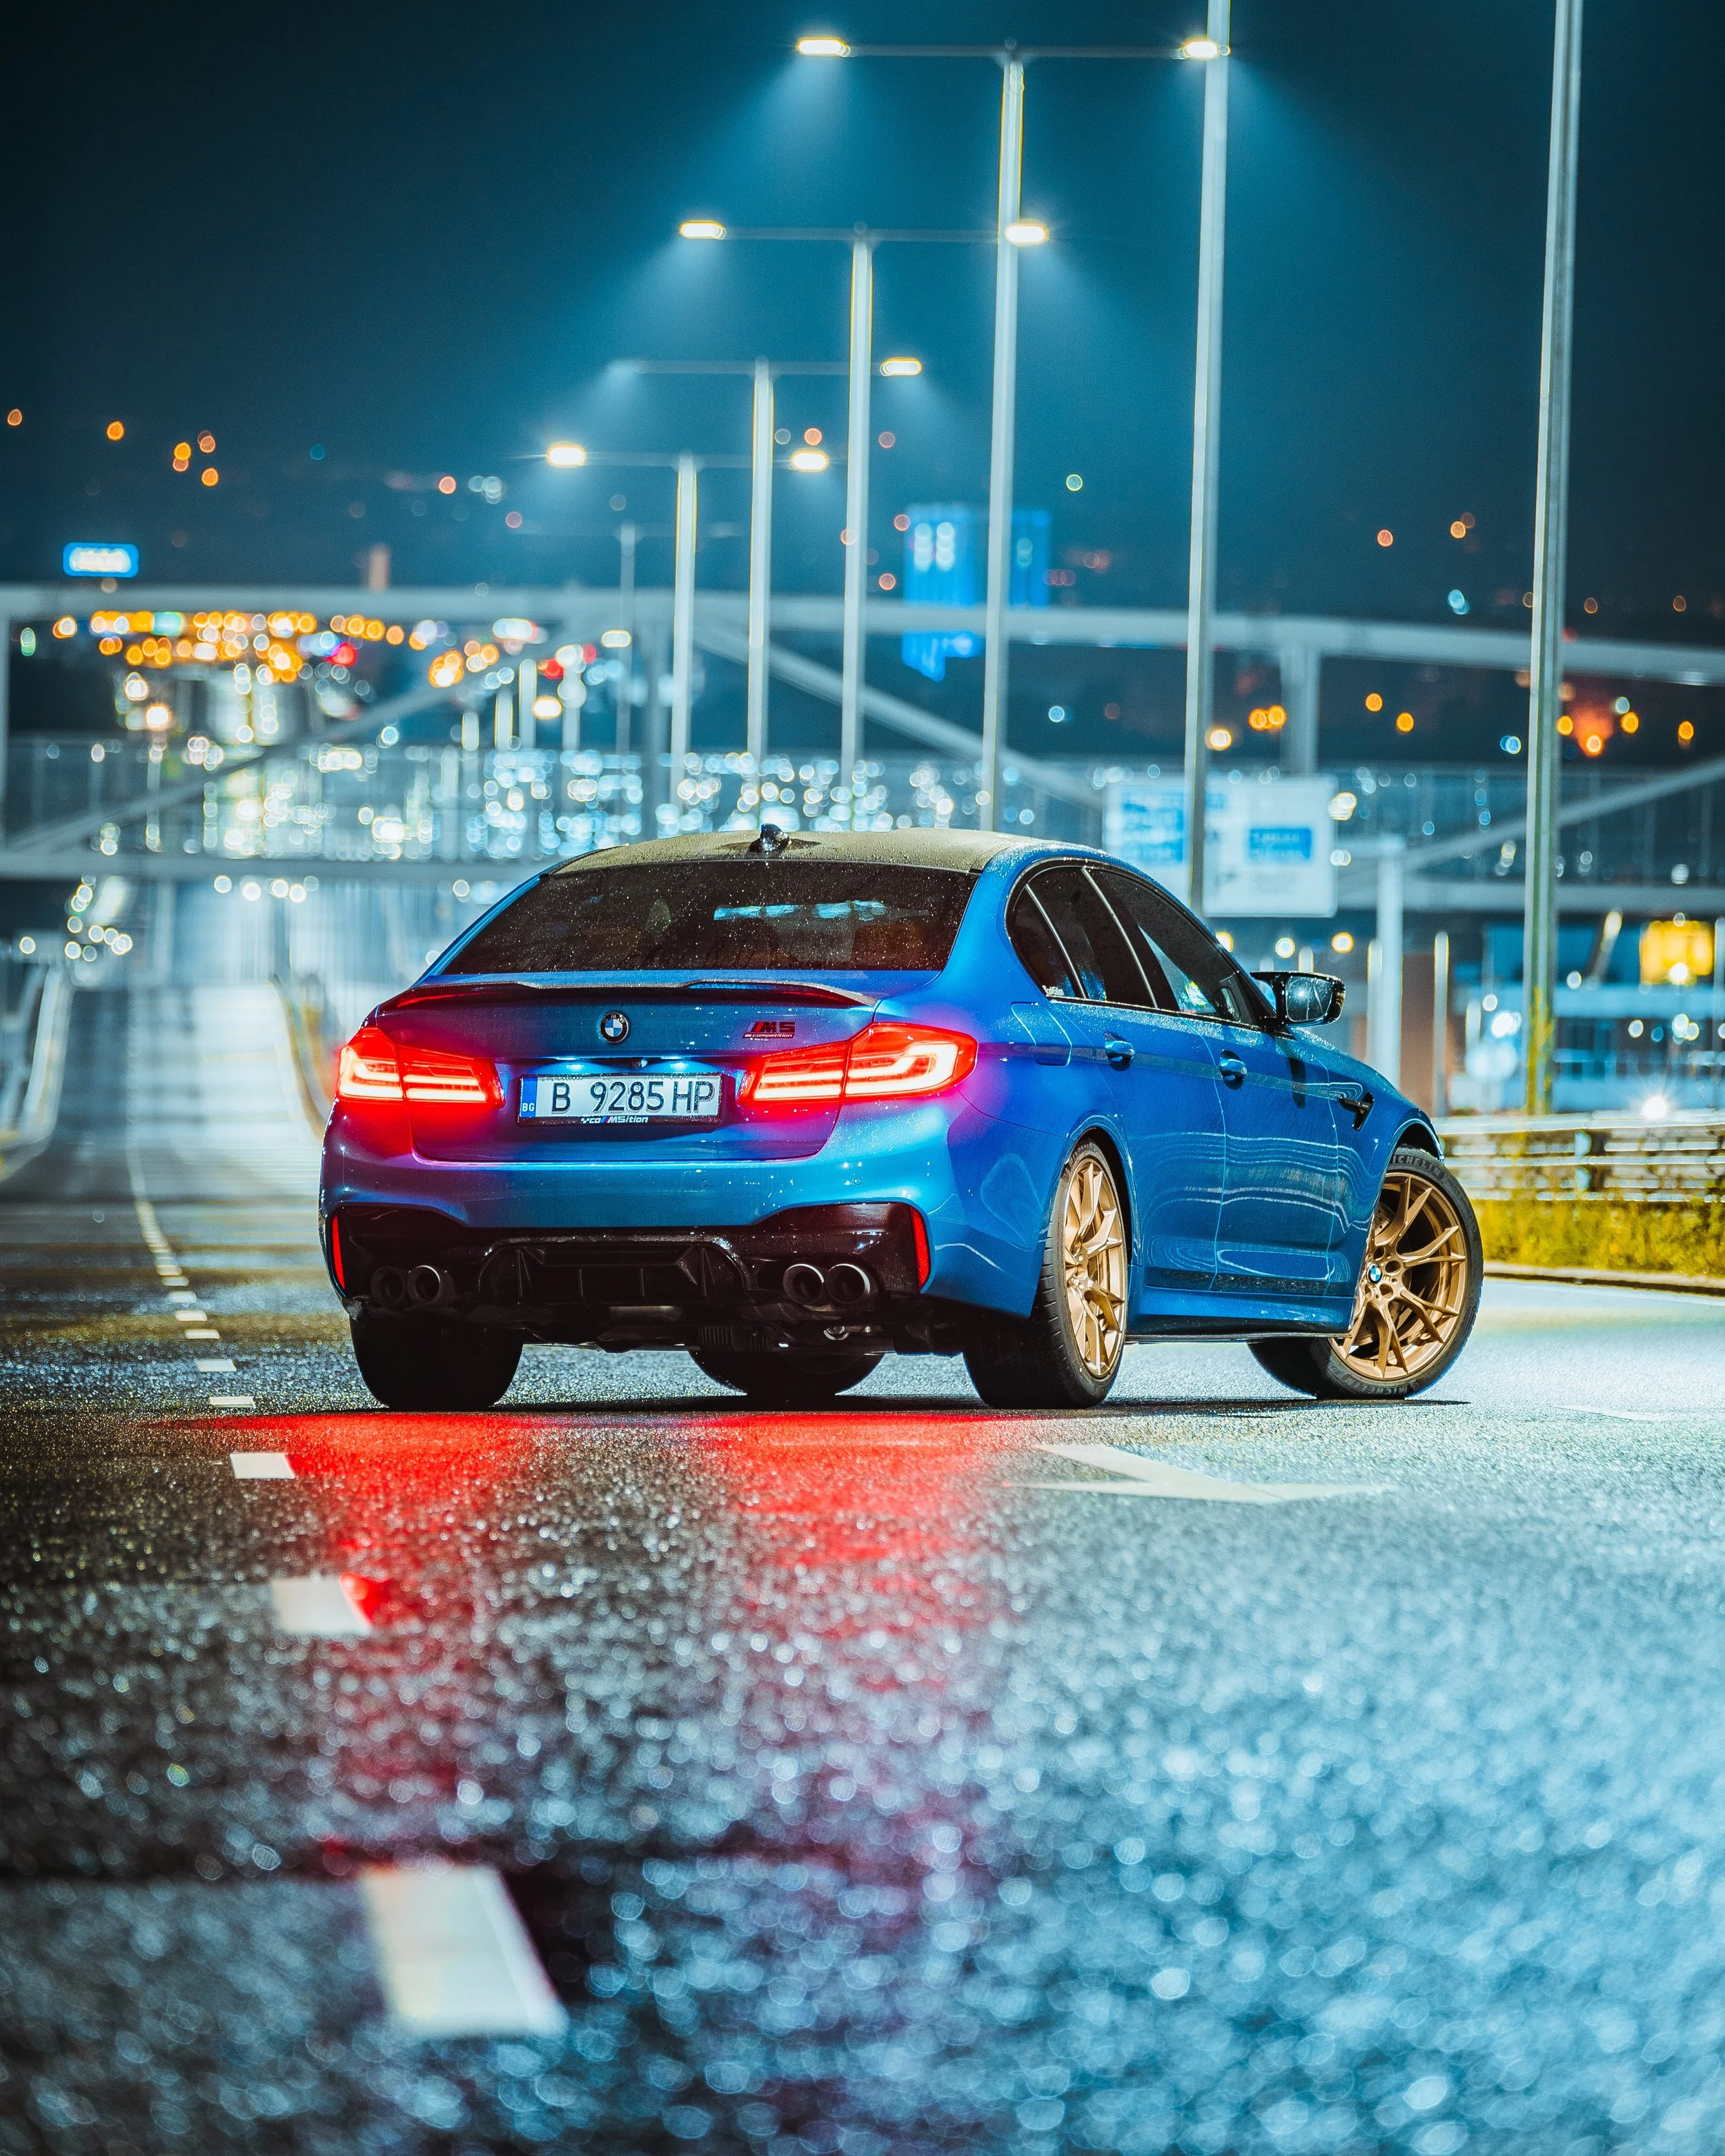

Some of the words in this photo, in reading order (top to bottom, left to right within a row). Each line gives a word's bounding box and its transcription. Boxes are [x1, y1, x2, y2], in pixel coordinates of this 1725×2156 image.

[747, 1022, 795, 1032] M5
[552, 1082, 571, 1112] B
[590, 1081, 664, 1112] 9285
[671, 1081, 713, 1112] HP
[522, 1102, 535, 1112] BG
[1392, 1156, 1441, 1177] ICHELIN
